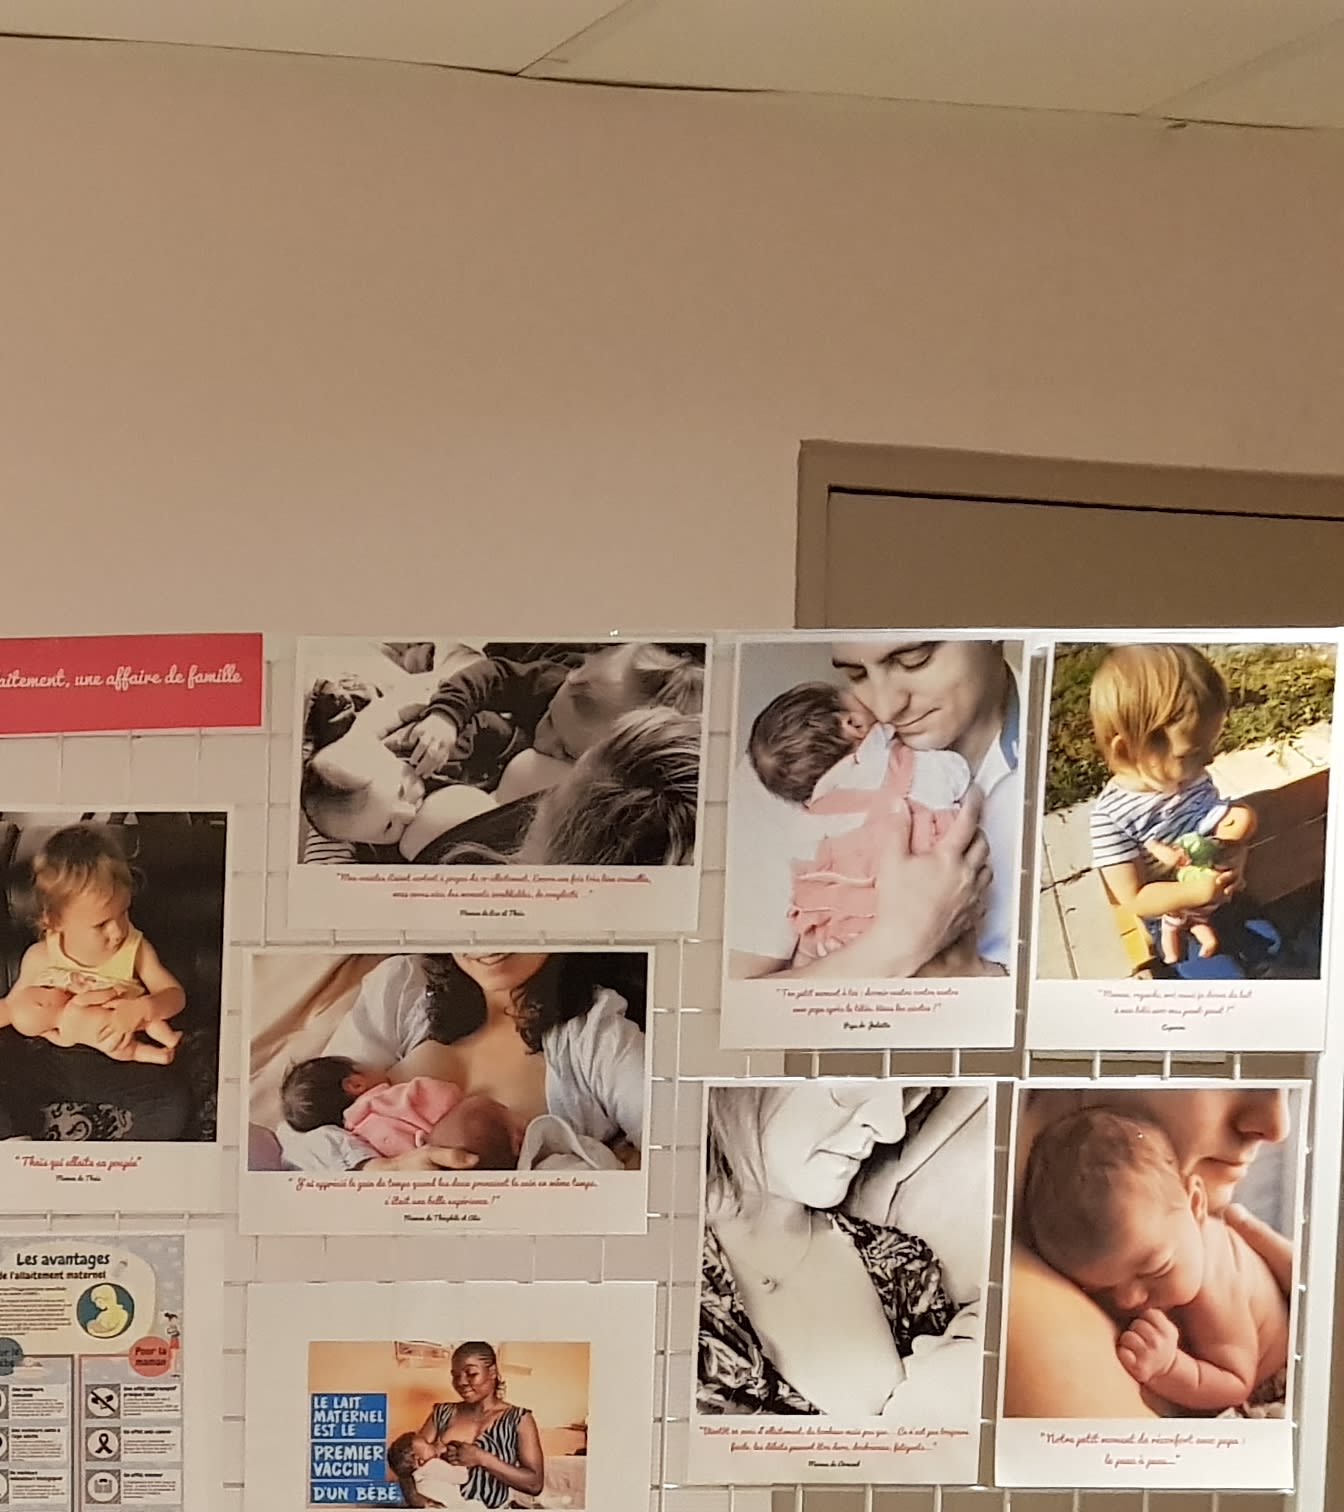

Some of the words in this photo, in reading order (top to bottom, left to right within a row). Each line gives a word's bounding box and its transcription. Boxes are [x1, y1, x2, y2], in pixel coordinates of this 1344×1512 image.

[75, 676, 103, 685] une
[106, 667, 162, 690] affaire
[165, 664, 185, 683] de
[188, 664, 242, 688] famille
[17, 1254, 37, 1265] Les
[41, 1253, 110, 1270] avantages
[67, 1269, 106, 1279] maternel
[314, 1397, 328, 1409] LE
[334, 1397, 362, 1409] LAIT
[314, 1410, 384, 1423] MATERNEL
[314, 1424, 336, 1436] EST
[342, 1424, 355, 1436] LE
[315, 1445, 383, 1461] PREMIER
[313, 1462, 368, 1476] VACCIN
[314, 1487, 348, 1500] D'UN
